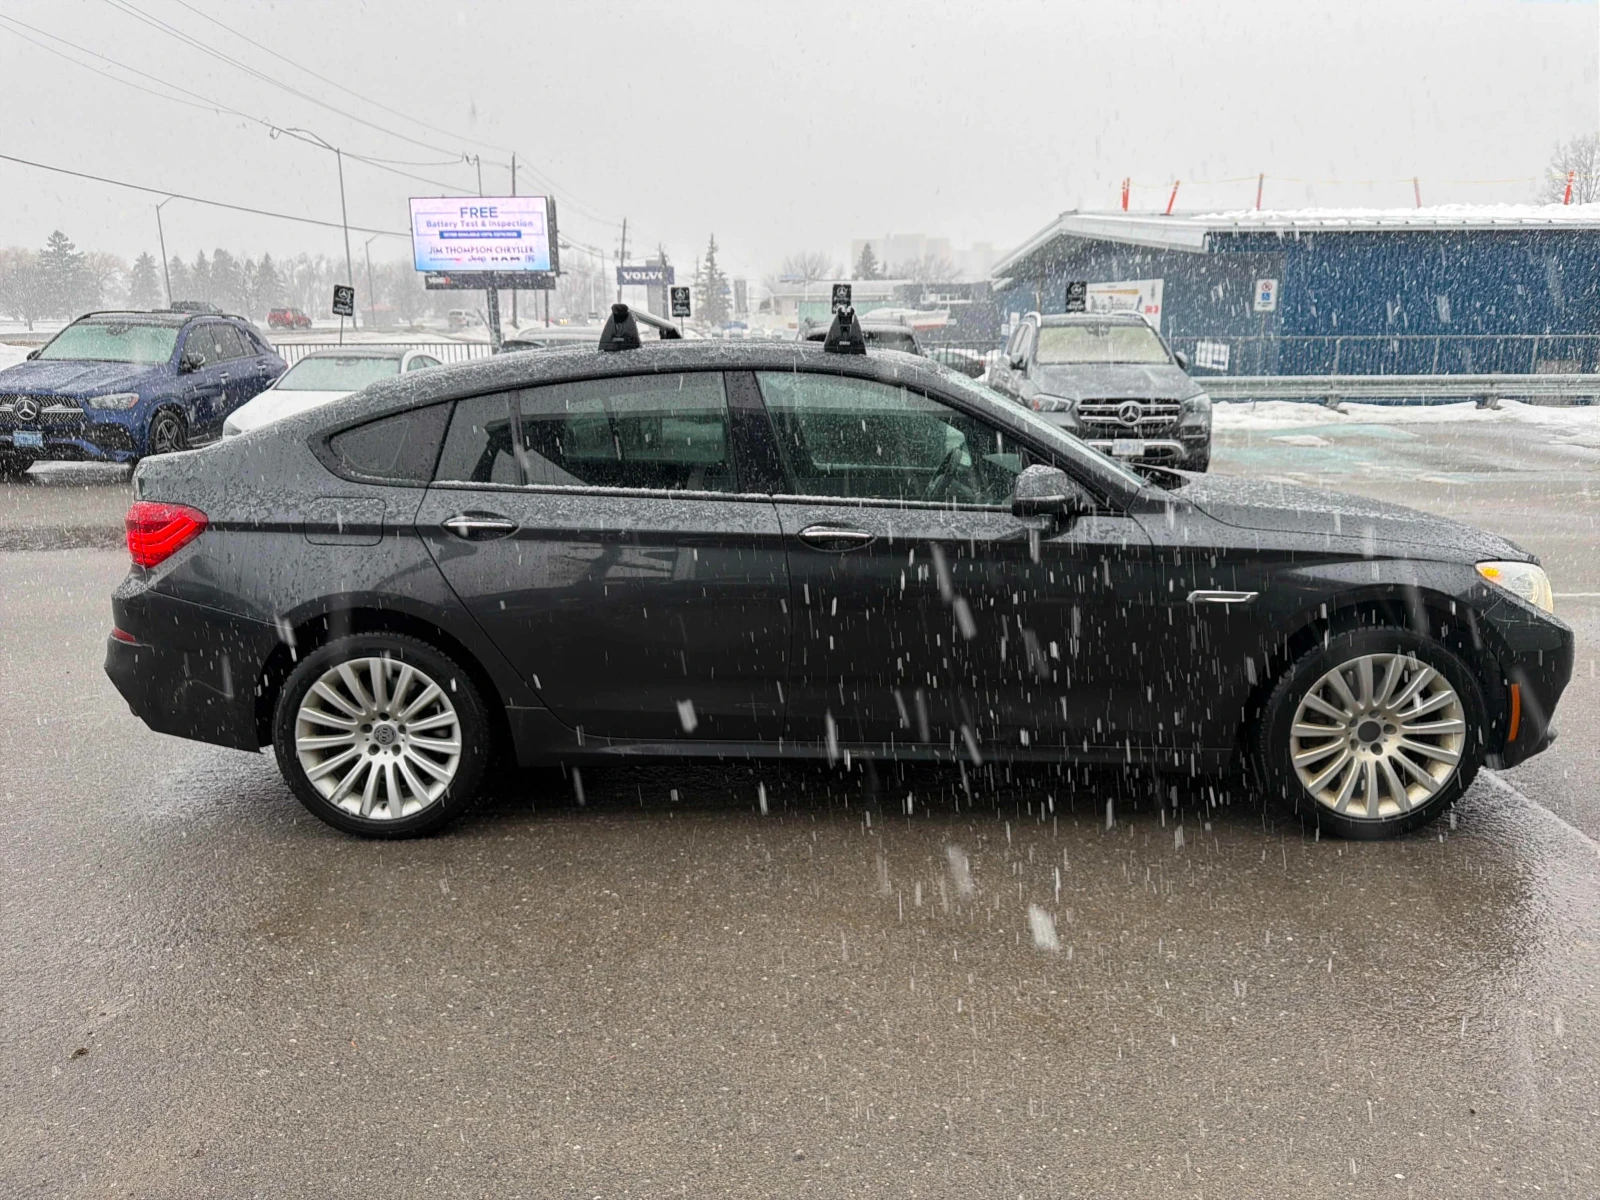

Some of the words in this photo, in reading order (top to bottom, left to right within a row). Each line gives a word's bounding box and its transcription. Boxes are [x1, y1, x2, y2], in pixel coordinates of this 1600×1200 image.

[460, 206, 498, 218] FREE
[426, 220, 458, 229] Battery
[460, 220, 479, 228] Test
[481, 220, 487, 228] &
[489, 219, 533, 228] Inspection
[445, 246, 493, 254] THOMPSON
[495, 246, 535, 254] CHRYSLER
